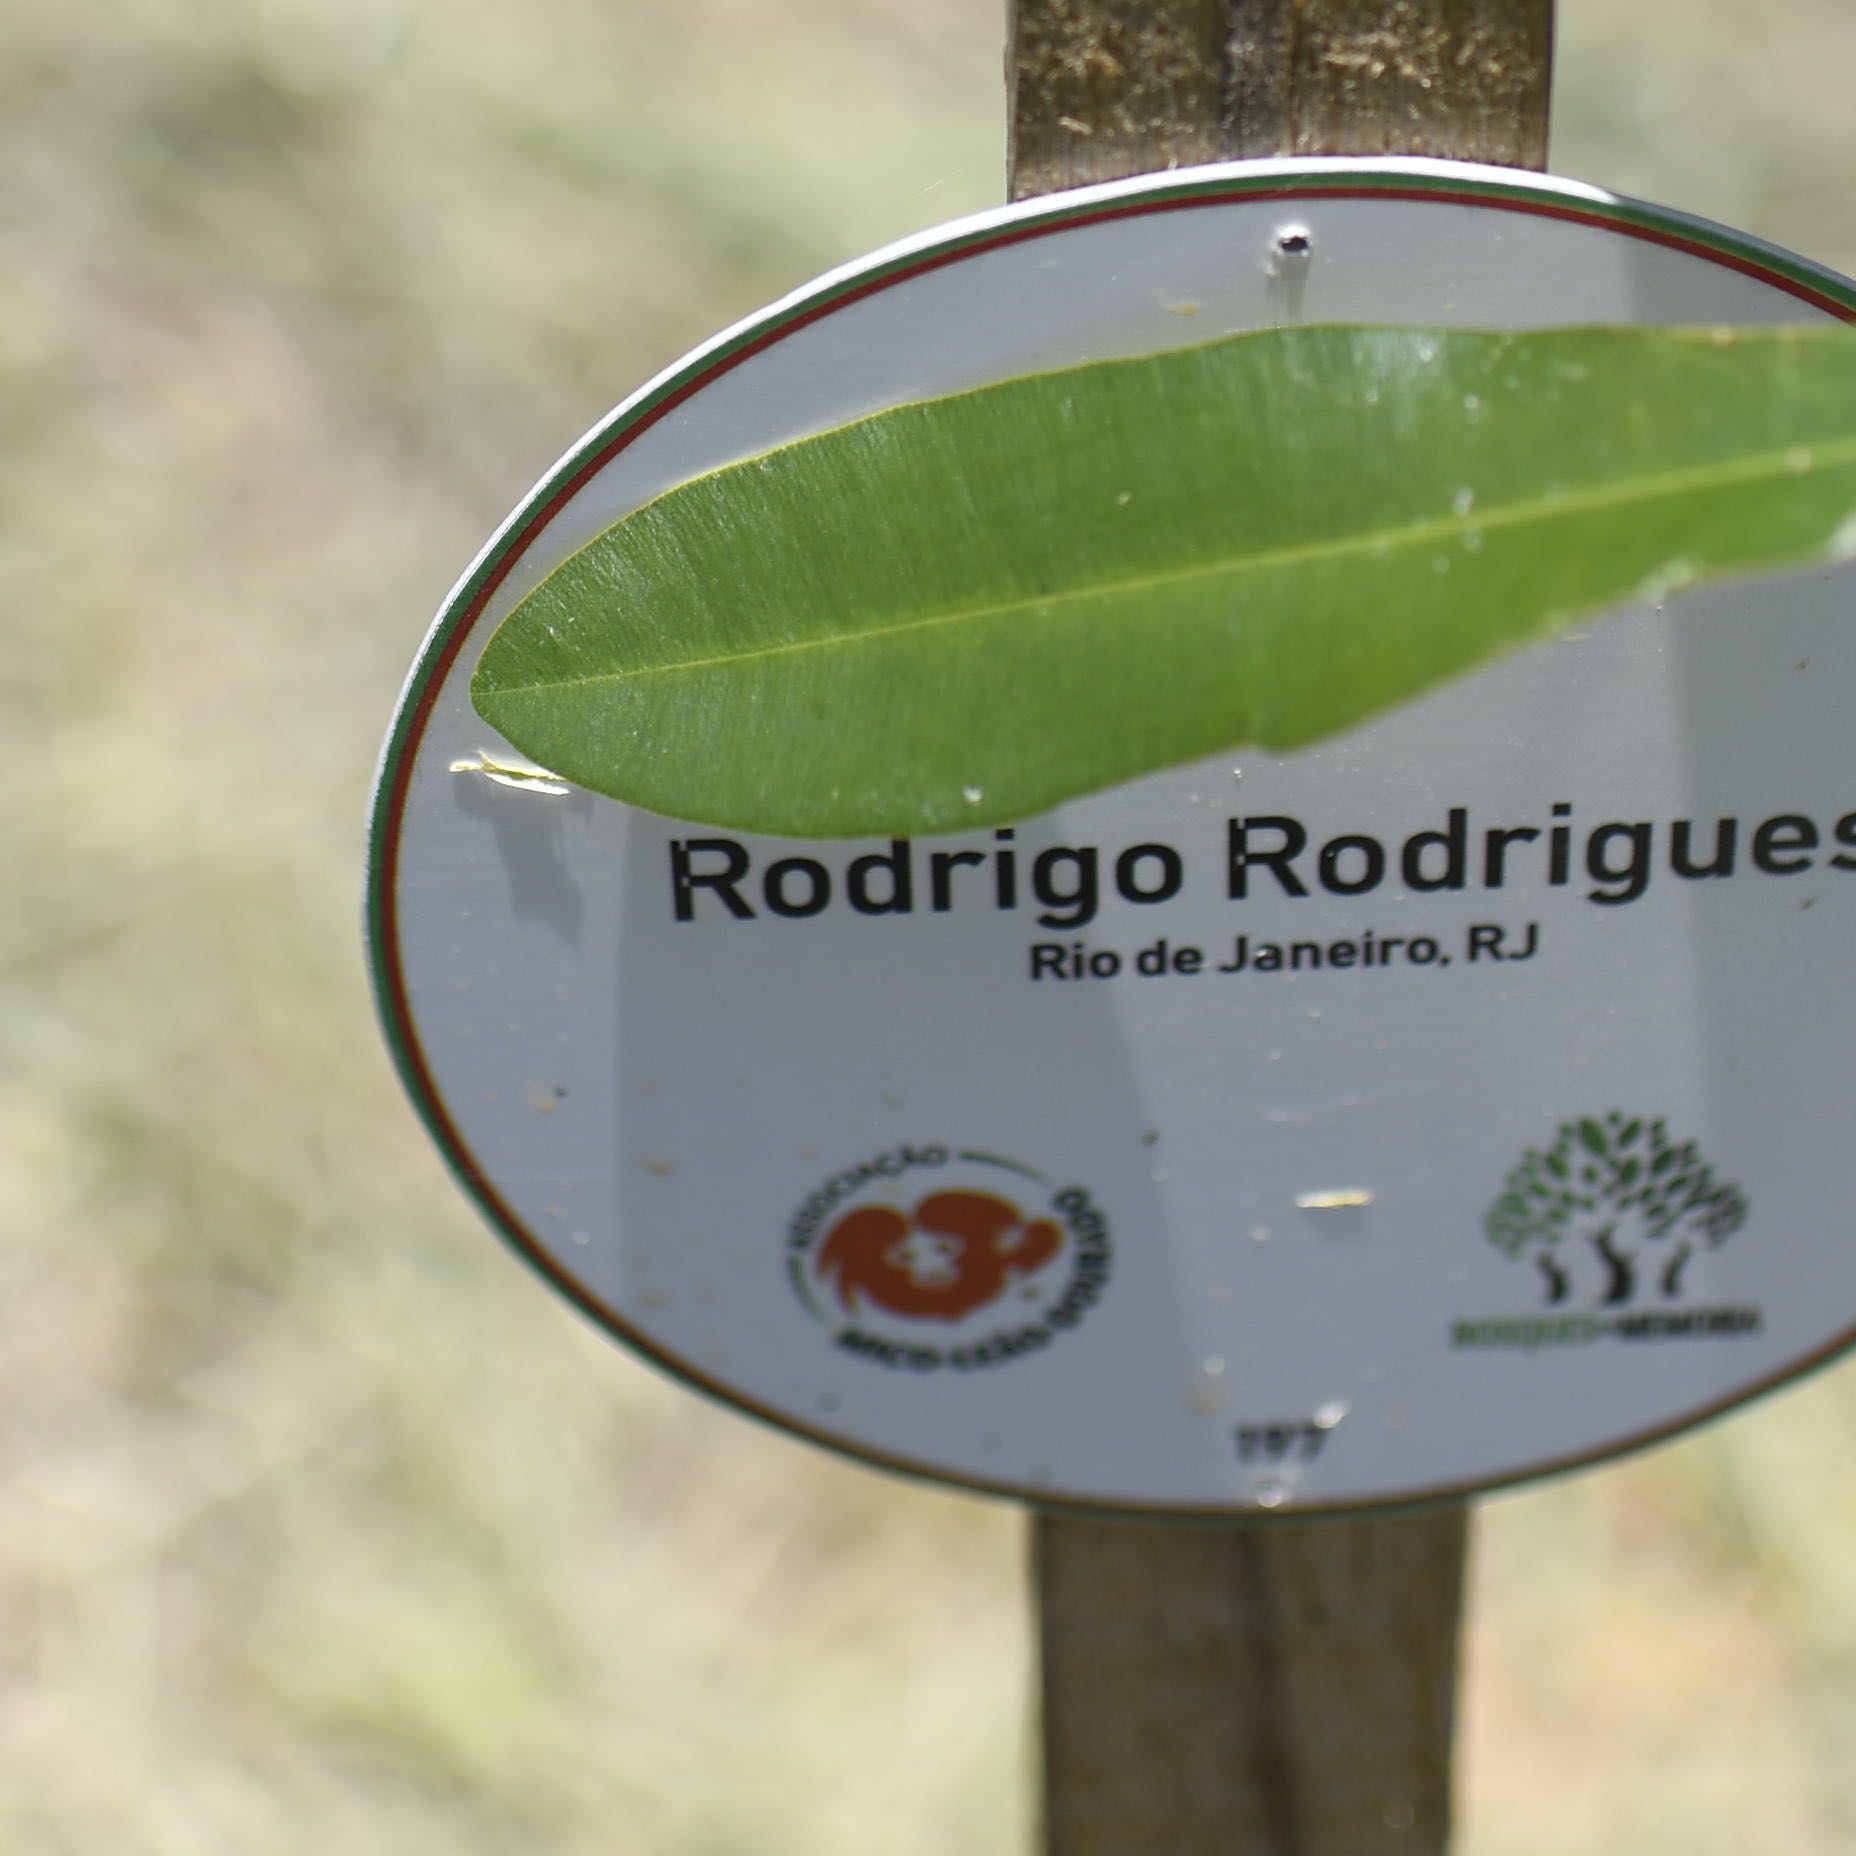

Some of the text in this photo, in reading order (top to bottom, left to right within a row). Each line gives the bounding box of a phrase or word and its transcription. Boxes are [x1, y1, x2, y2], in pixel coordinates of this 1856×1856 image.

[668, 827, 1184, 931] Rodrigo
[1029, 923, 1538, 983] Rio de Janeiro, RJ
